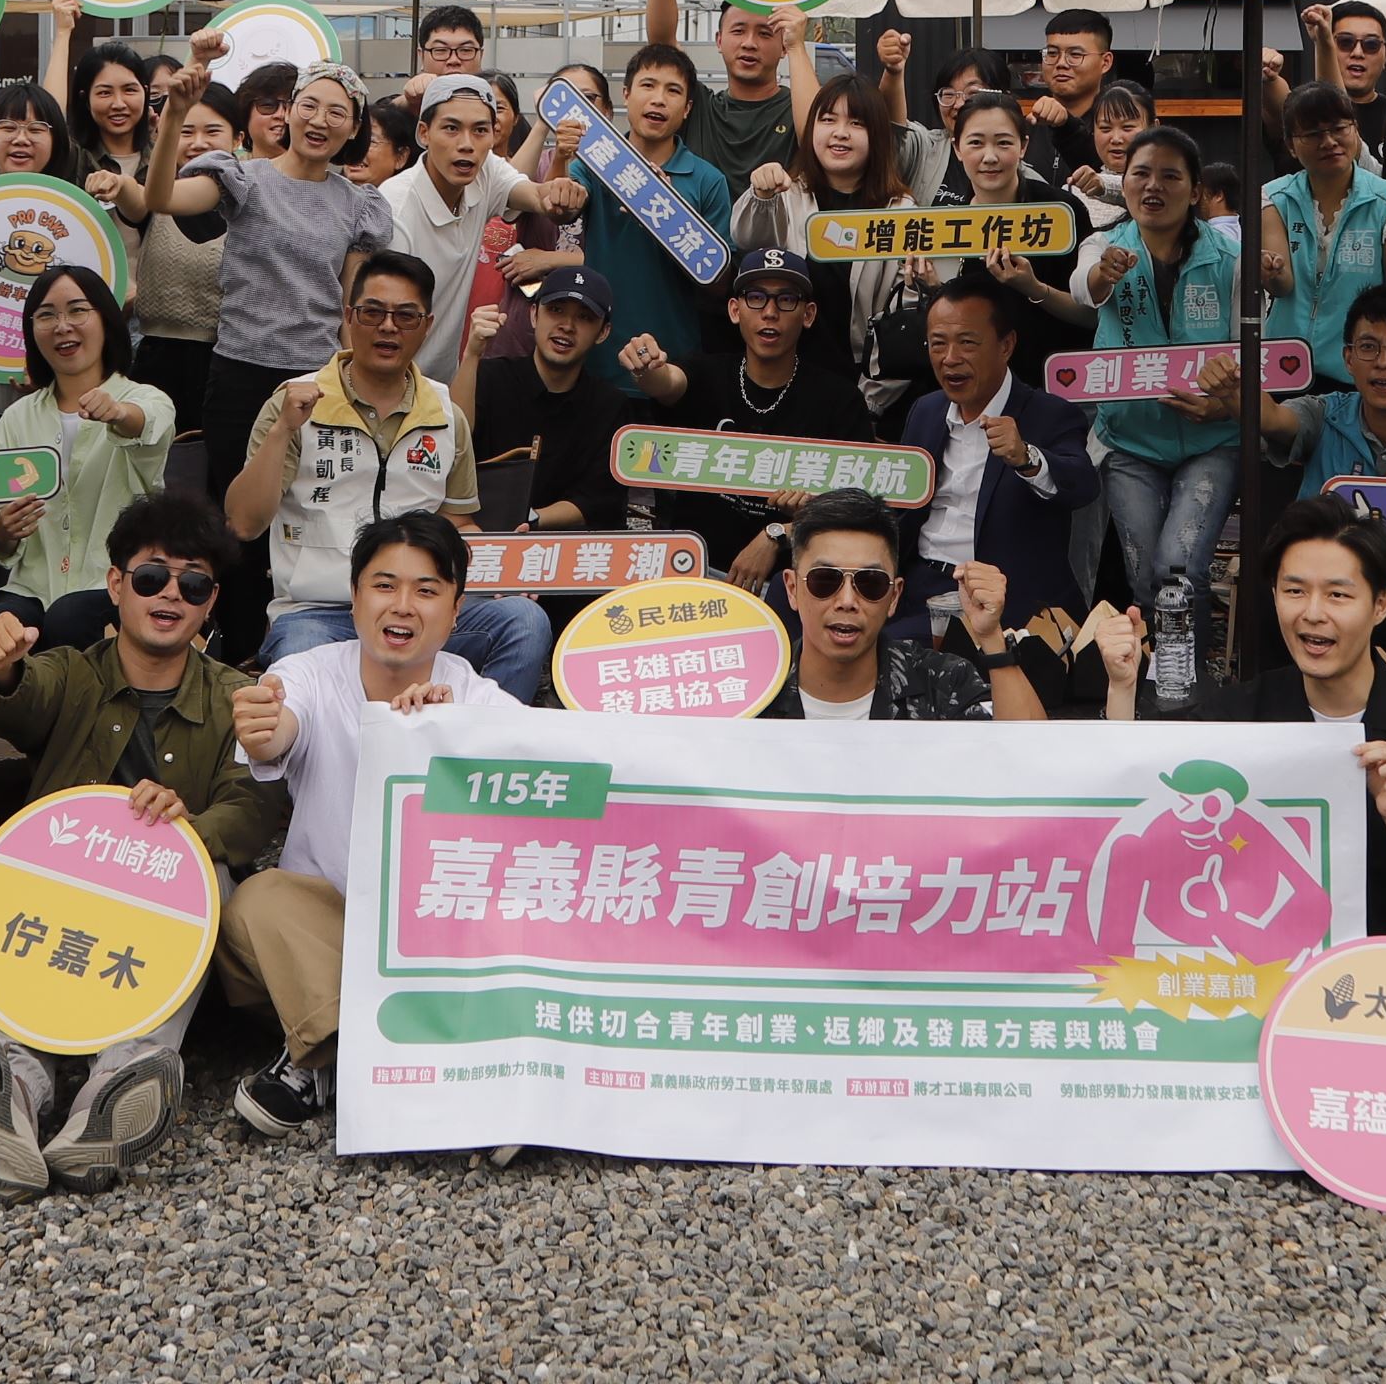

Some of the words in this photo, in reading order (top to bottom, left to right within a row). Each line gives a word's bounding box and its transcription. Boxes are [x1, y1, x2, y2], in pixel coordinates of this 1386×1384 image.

[8, 209, 37, 229] PRO
[37, 210, 69, 241] CAKE
[865, 213, 1053, 253] 增能工作坊
[671, 440, 911, 495] 青年創業啟航
[464, 542, 668, 583] 嘉創業潮
[638, 598, 728, 628] 民雄鄉
[597, 643, 746, 687] 民雄商圈
[599, 675, 750, 714] 發展協會
[465, 769, 570, 808] 115年
[82, 823, 182, 883] 竹崎鄉
[414, 835, 1079, 940] 嘉義縣青創培力站
[0, 910, 147, 991] 佇嘉木
[535, 1000, 1161, 1052] 提供切合青年創業、返鄉及發展方案與機會
[375, 1068, 433, 1083] 指導單位
[442, 1061, 566, 1083] 勞動部勞動力發展署
[588, 1070, 642, 1088] 主辦單位
[650, 1073, 833, 1096] 嘉義縣政府勞工暨青年發展處
[851, 1080, 906, 1096] 承辦單位
[914, 1080, 1032, 1098] 將才工場有限公司
